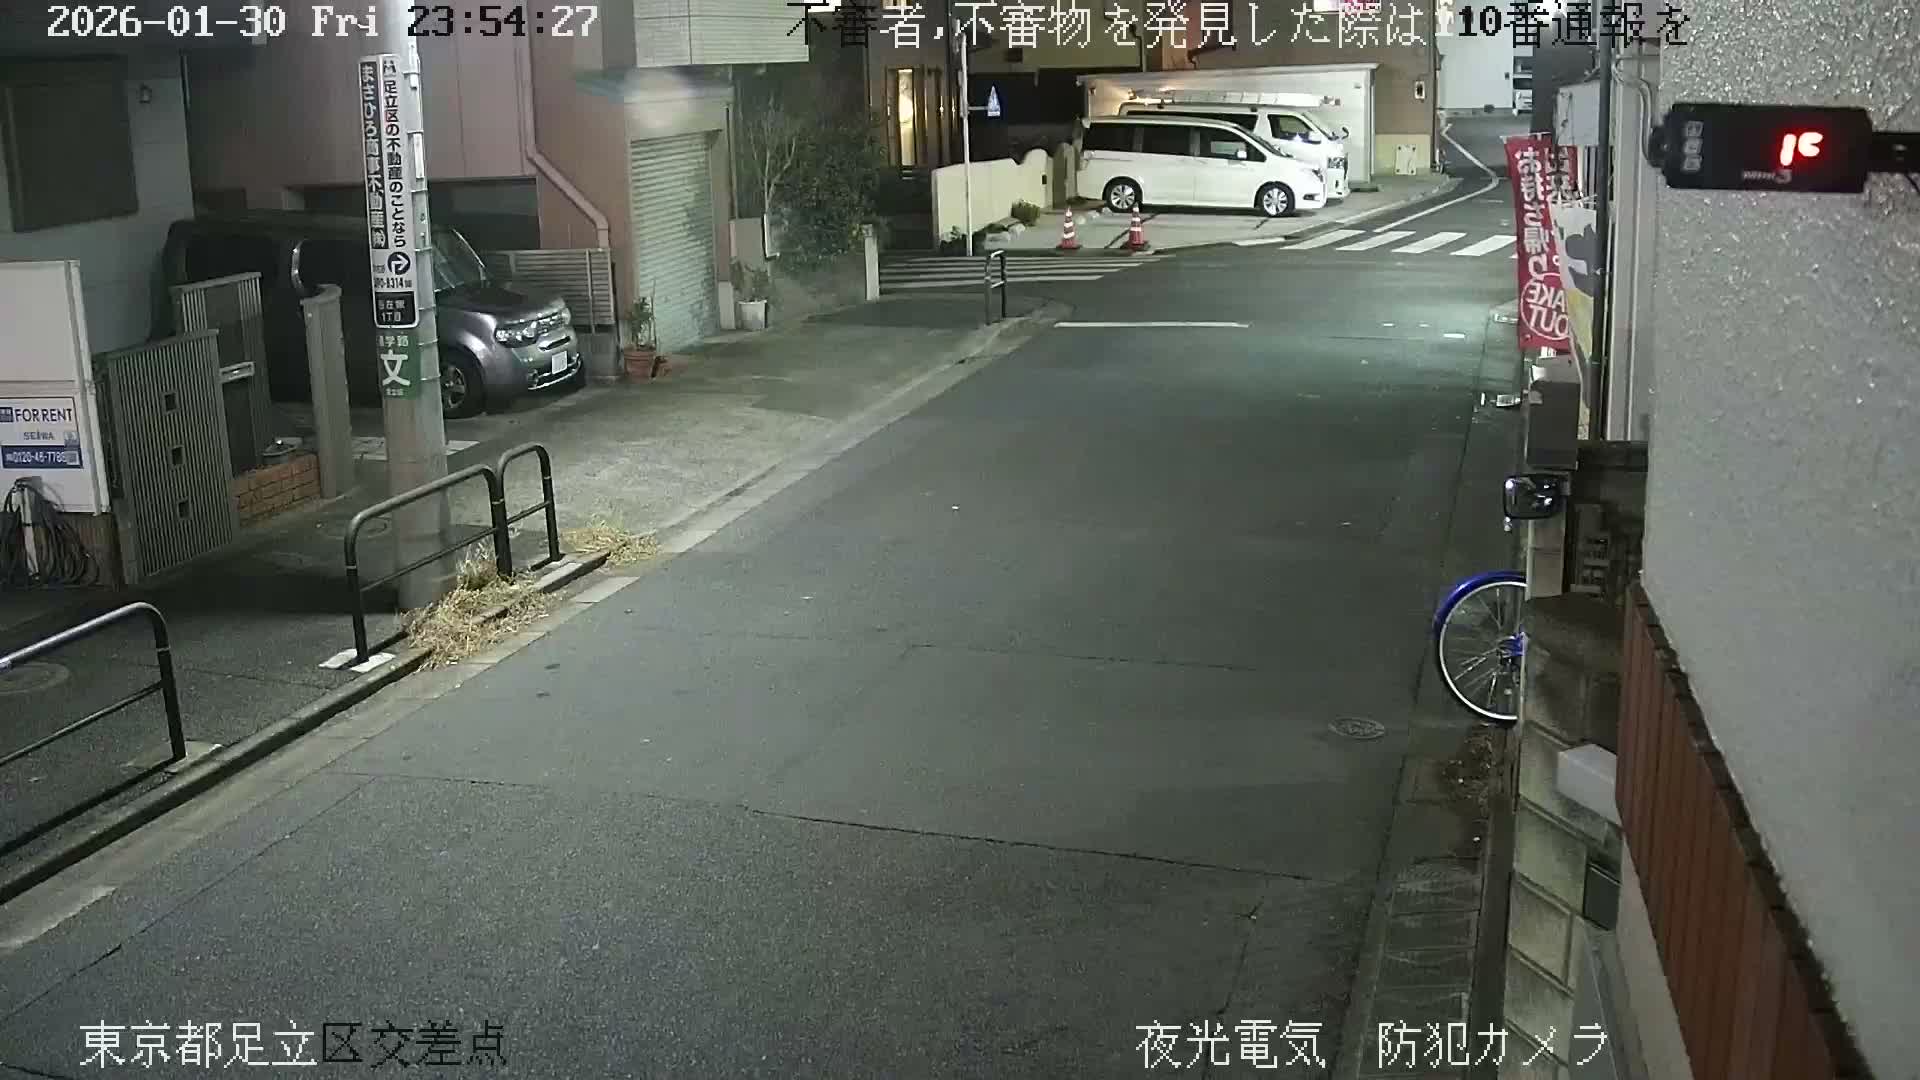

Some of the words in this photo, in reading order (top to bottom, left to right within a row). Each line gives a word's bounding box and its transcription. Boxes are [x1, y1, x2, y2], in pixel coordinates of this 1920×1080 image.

[380, 349, 411, 386] 文
[14, 408, 39, 422] FOR
[41, 408, 72, 422] RENT
